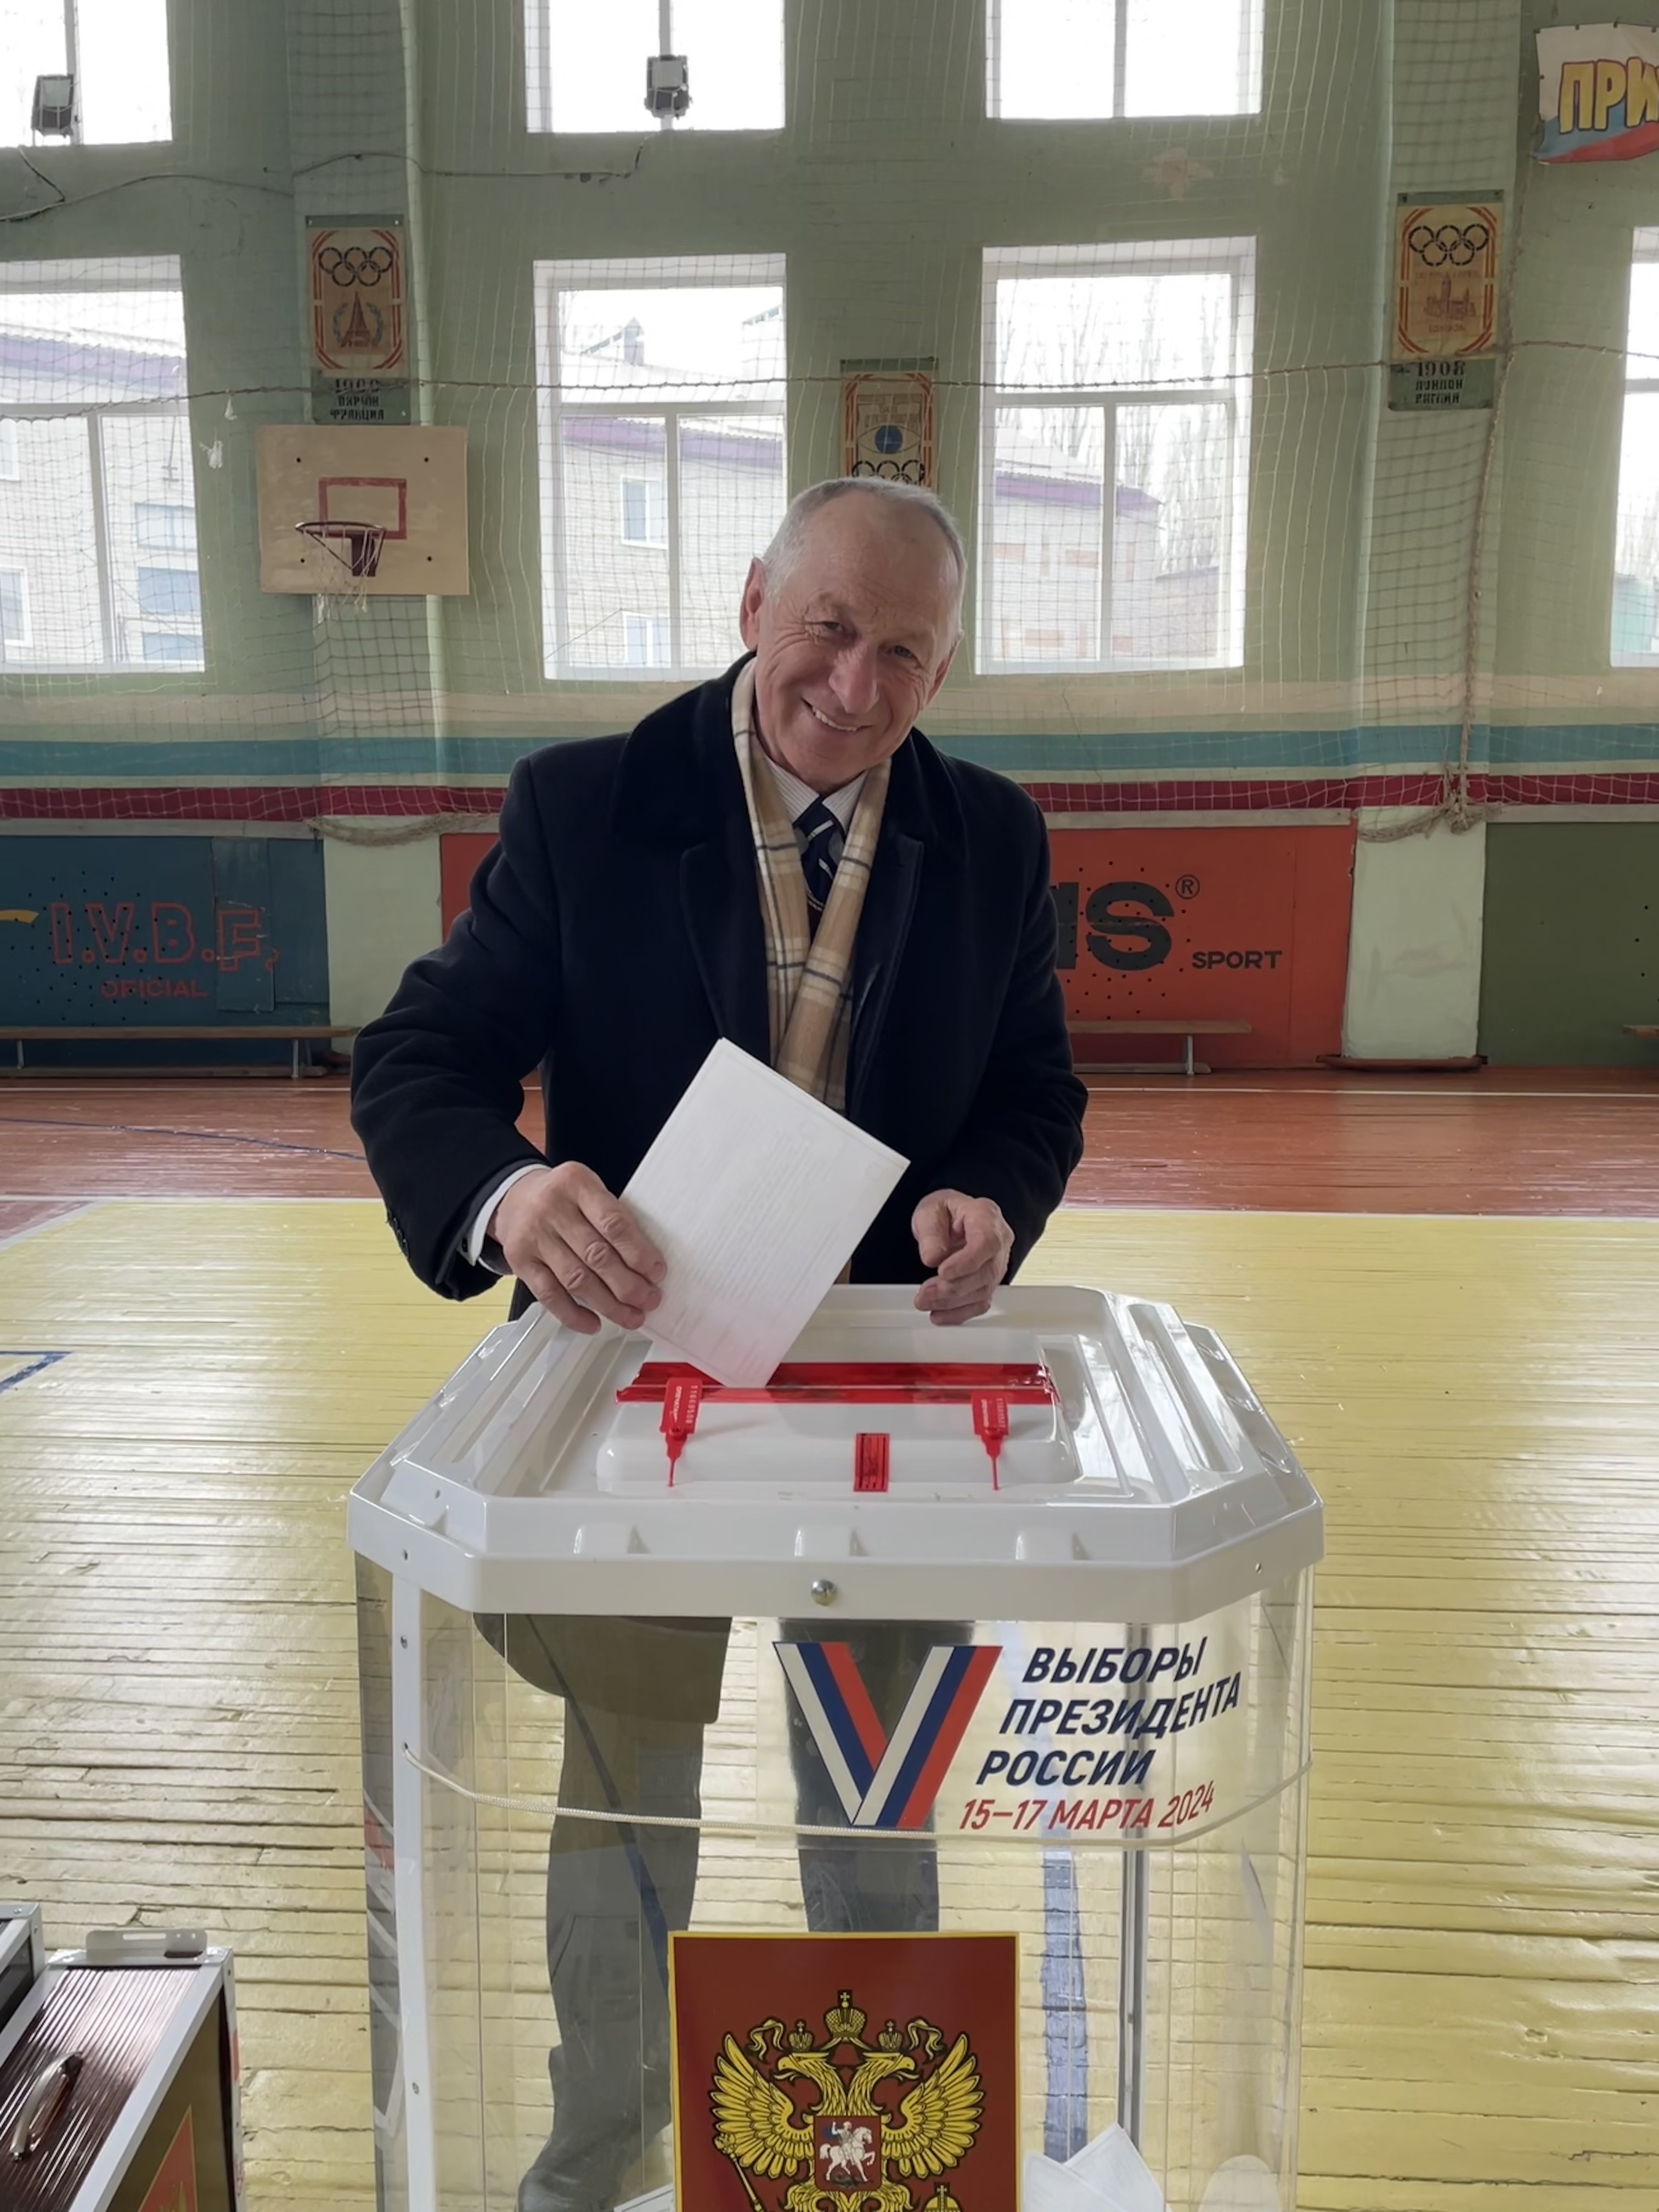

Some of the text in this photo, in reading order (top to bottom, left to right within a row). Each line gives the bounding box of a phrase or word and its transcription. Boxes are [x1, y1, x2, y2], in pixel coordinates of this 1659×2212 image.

[1558, 57, 1659, 135] ПРИ
[1418, 360, 1465, 376] 1908
[1192, 950, 1282, 969] SPORT
[100, 979, 208, 998] OFICIAL
[1022, 1636, 1208, 1683] ВЫБОРЫ
[998, 1672, 1241, 1740] ПРЕЗИДЕНТА
[975, 1749, 1156, 1786] РОССИИ
[1047, 1798, 1156, 1830] МАРТА
[1157, 1779, 1215, 1828] 2024
